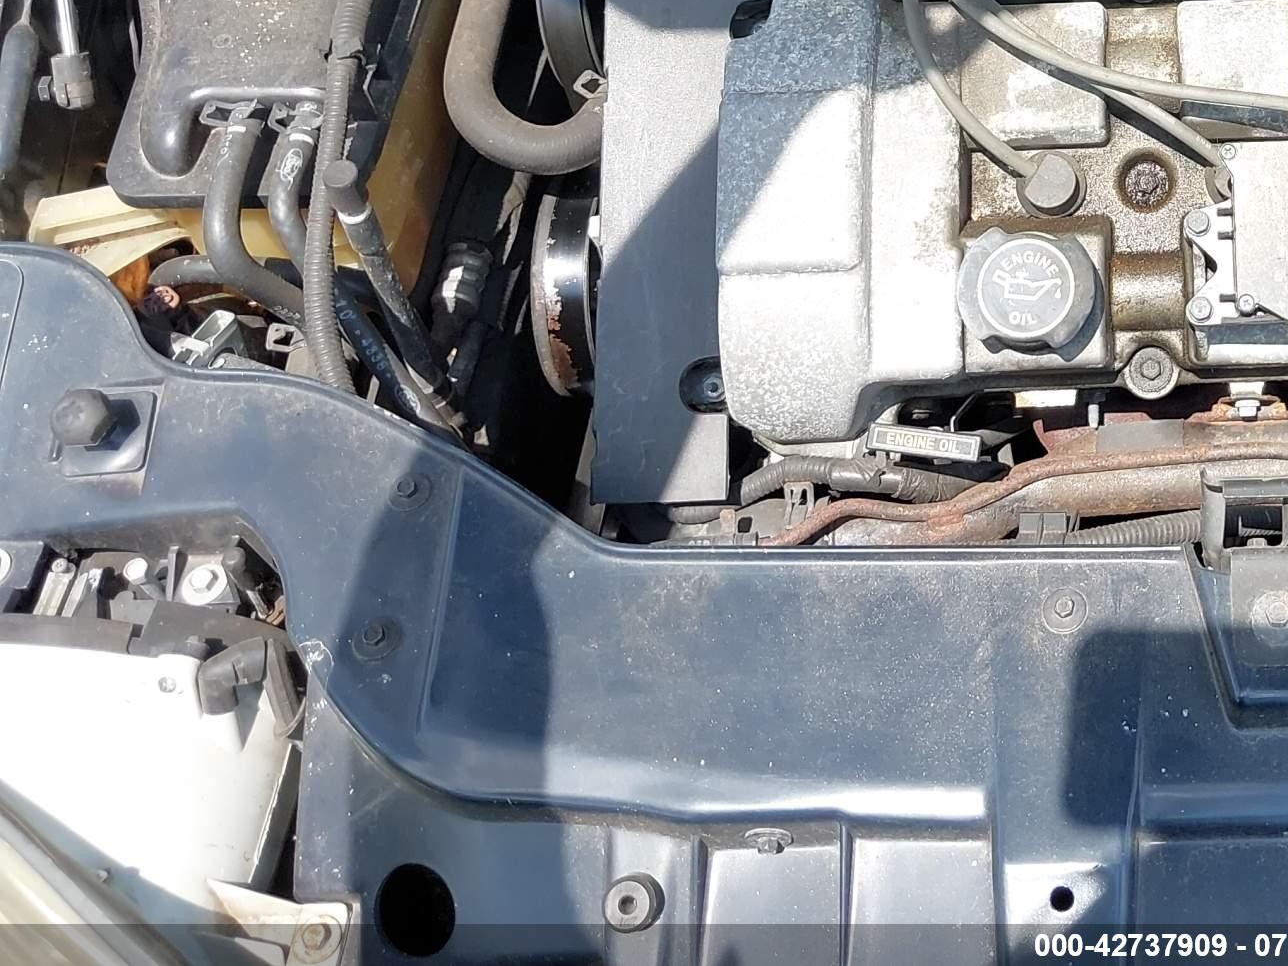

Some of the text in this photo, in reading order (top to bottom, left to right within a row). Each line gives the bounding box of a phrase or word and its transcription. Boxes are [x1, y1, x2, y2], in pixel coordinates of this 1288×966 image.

[1000, 250, 1059, 278] ENGINE
[1008, 311, 1038, 325] OIL
[886, 433, 960, 453] ENGINE OIL
